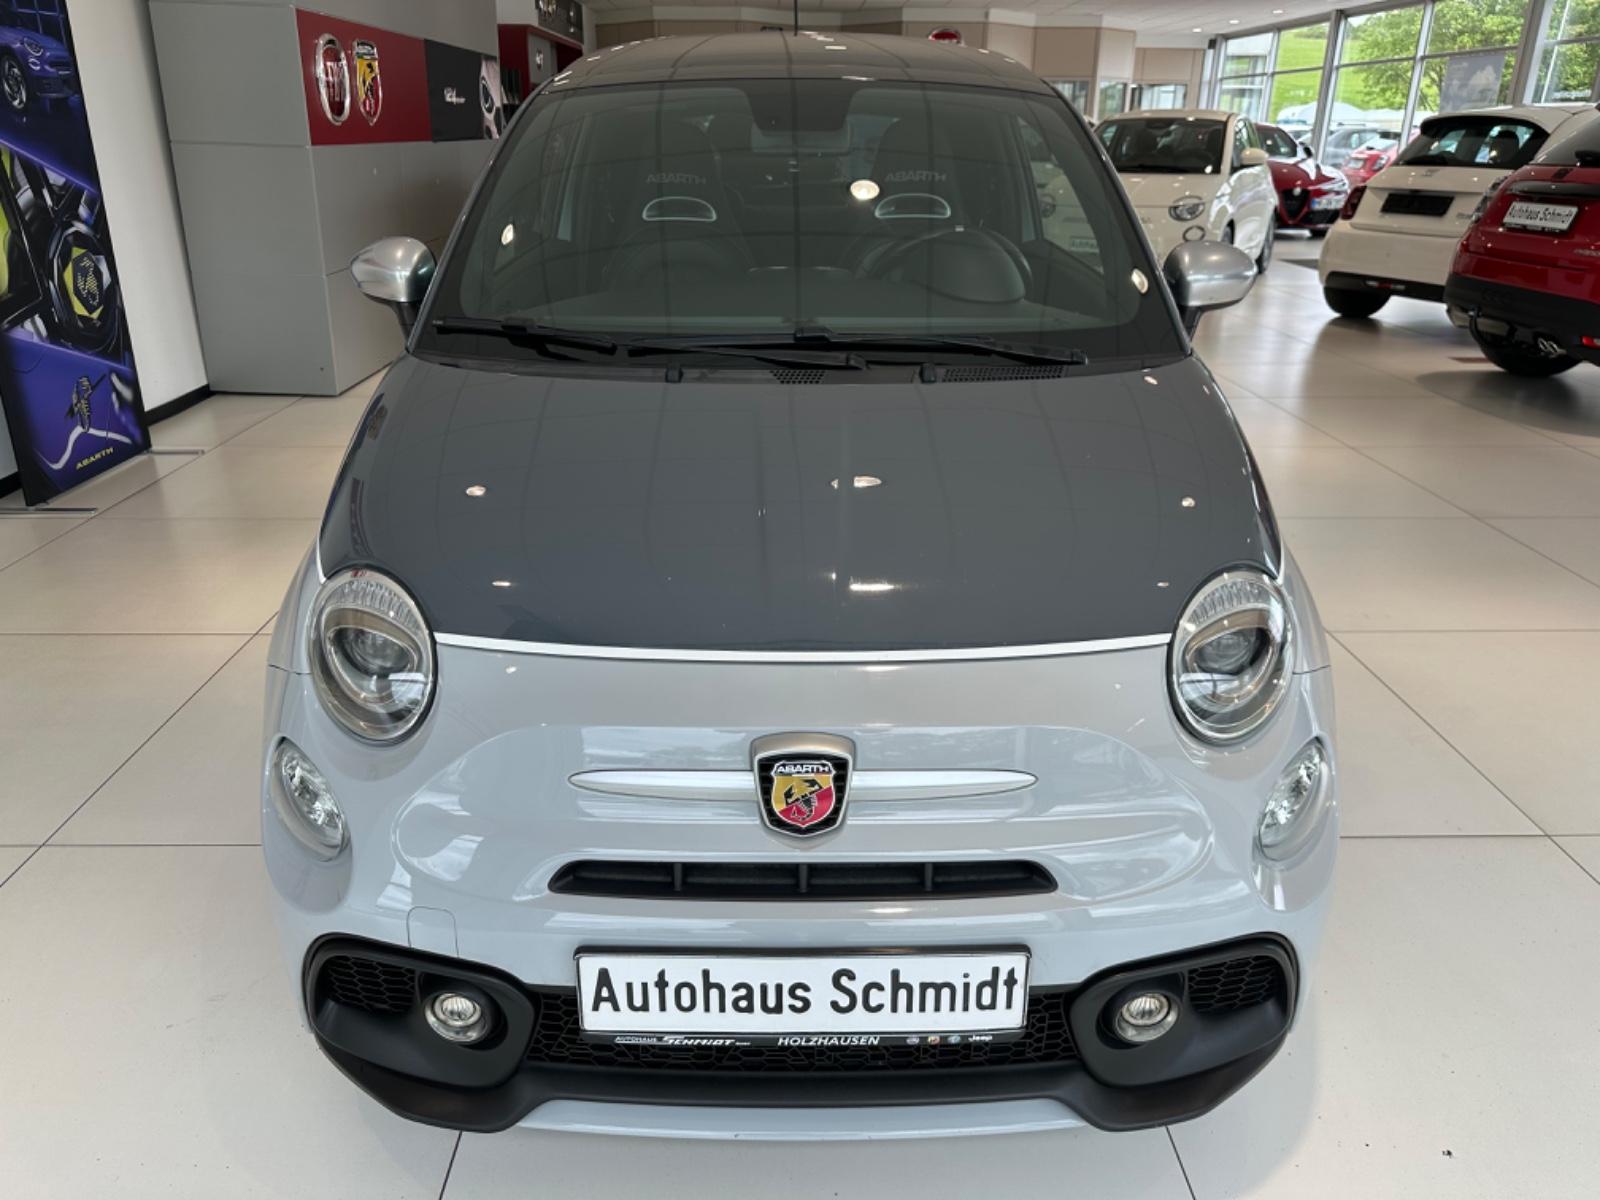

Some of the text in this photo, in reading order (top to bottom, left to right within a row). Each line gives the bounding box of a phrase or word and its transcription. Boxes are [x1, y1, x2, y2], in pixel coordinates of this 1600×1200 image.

[885, 170, 947, 182] ABARTH
[777, 764, 829, 773] ABARTH
[592, 966, 1017, 1014] Autohaus Schmidt
[777, 1036, 880, 1046] HOLZHAUSEN
